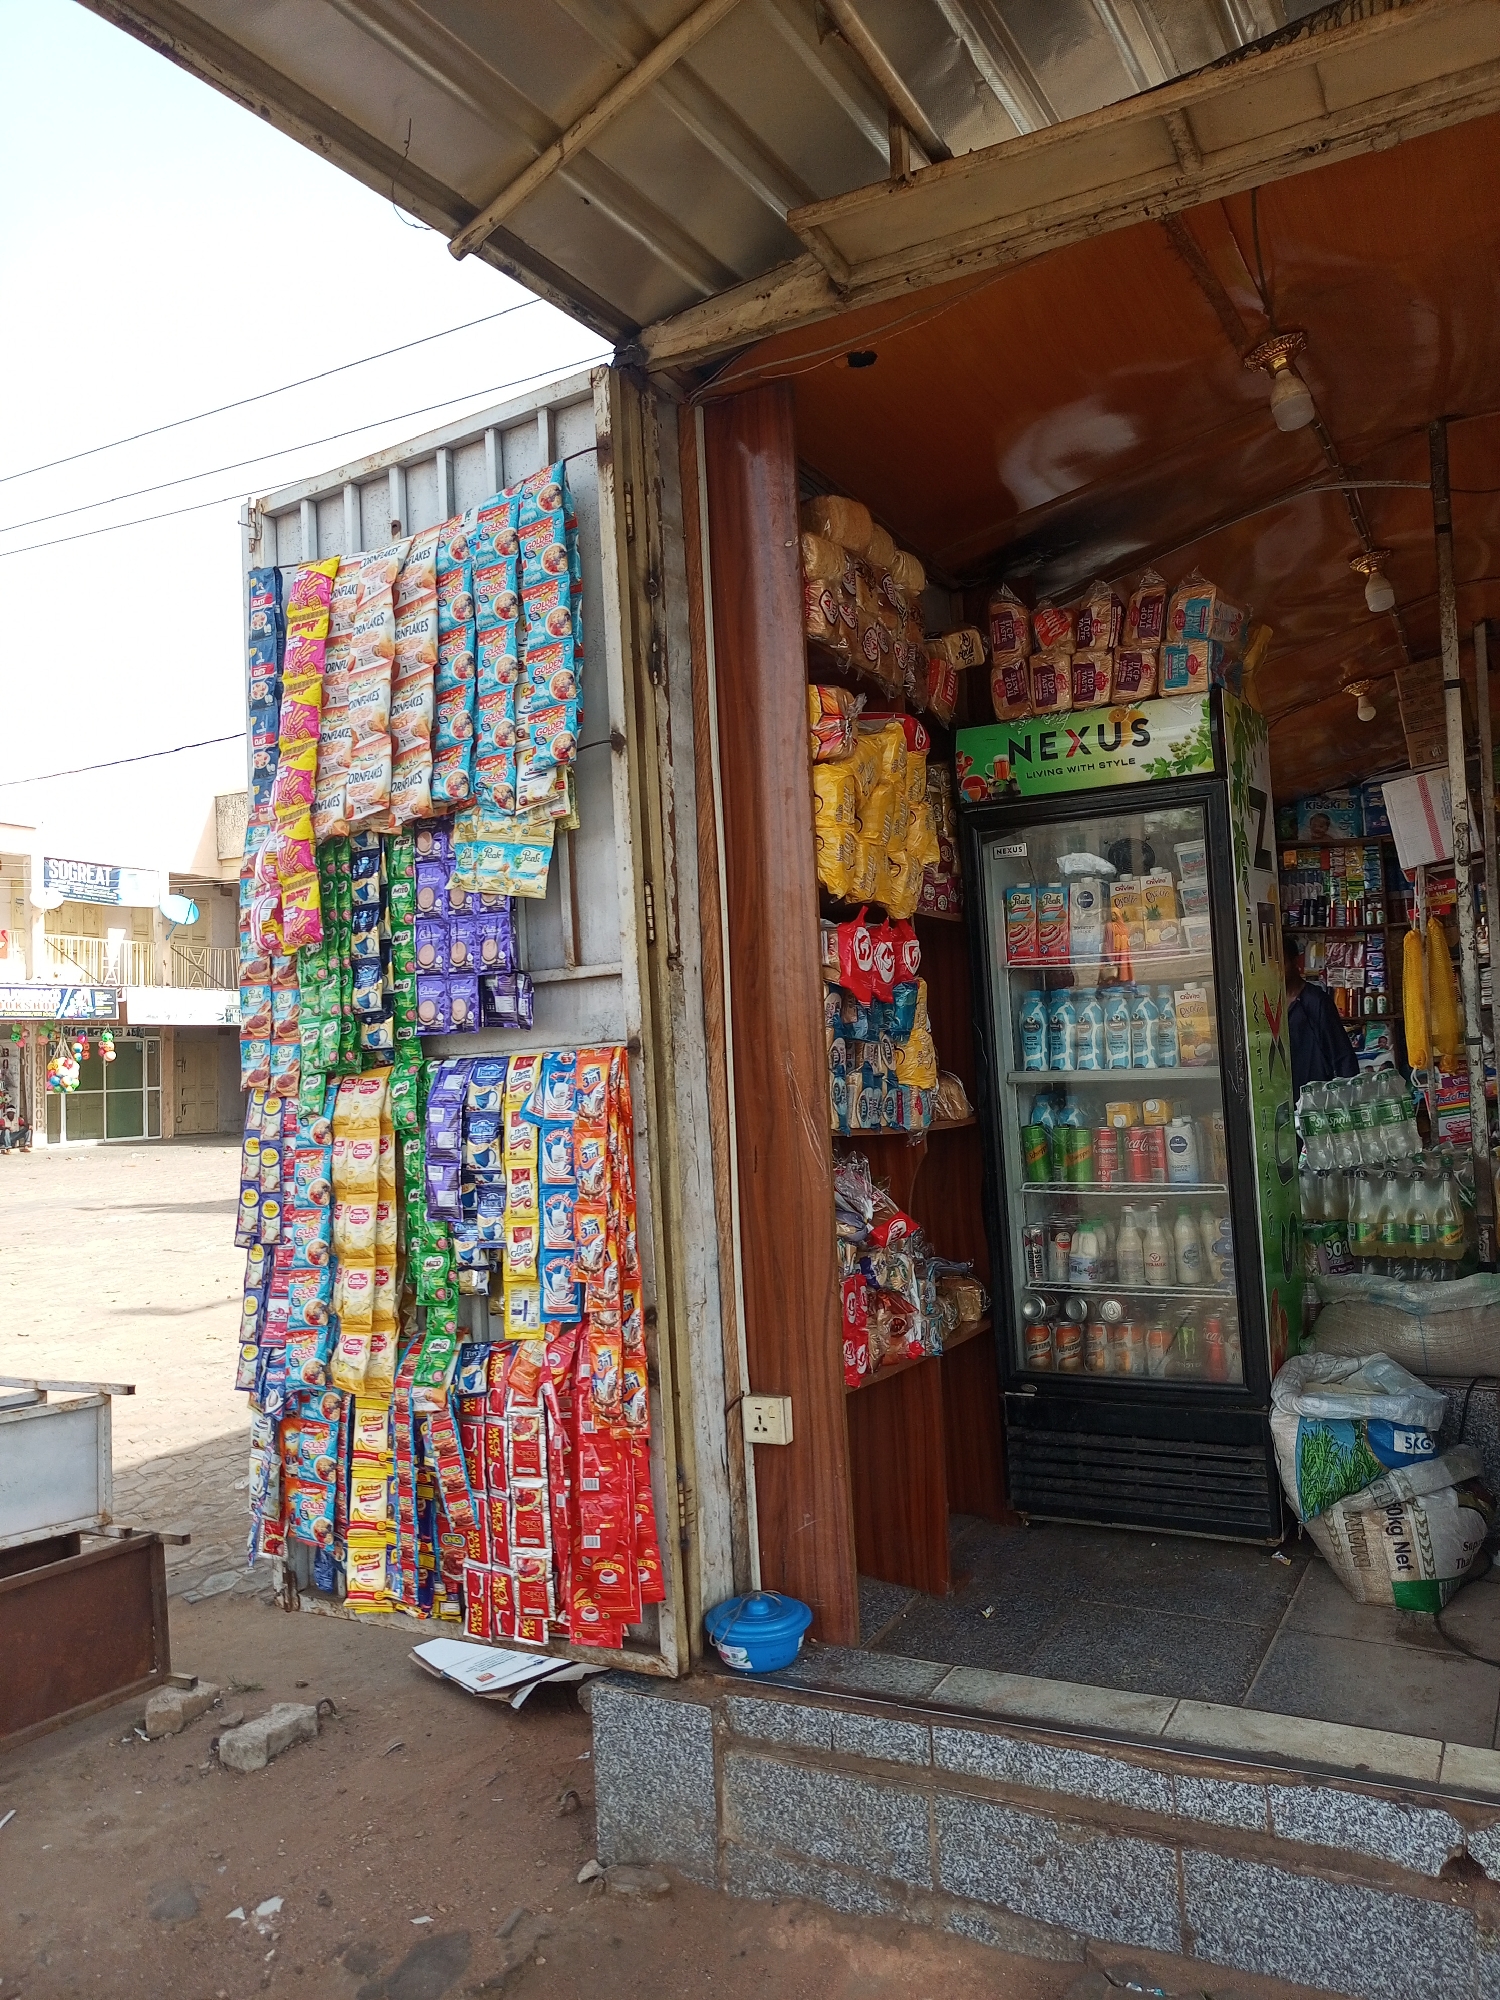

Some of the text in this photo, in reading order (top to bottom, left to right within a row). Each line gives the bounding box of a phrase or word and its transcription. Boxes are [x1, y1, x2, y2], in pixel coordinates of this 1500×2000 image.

[481, 518, 509, 534] GOLDEN
[525, 532, 554, 551] GOLDEN
[361, 545, 401, 567] CORNFLAKES
[331, 583, 358, 599] ORNFLAK
[479, 579, 507, 595] GOLDEN
[530, 593, 559, 613] GOLDEN
[352, 611, 385, 636] CORNFLAKES
[1139, 608, 1147, 628] TOP
[1145, 606, 1154, 629] TASTE
[999, 620, 1008, 642] TASTE
[1005, 620, 1014, 639] TOP
[1078, 617, 1086, 641] TASTE
[534, 656, 564, 676] GOLDEN
[1126, 662, 1134, 682] TASTE
[1005, 677, 1014, 697] TOP
[1010, 673, 1019, 695] TASTE
[1041, 674, 1049, 698] TASTE
[536, 718, 566, 737] GOLDEN
[254, 737, 267, 747] OATS
[1008, 718, 1150, 765] NEXUS
[346, 764, 384, 785] CORNFLAKES
[1026, 757, 1136, 779] LIVING WITH STYLE
[843, 786, 855, 825] LIGHT
[483, 846, 502, 859] Peak
[522, 848, 541, 863] Peak
[996, 846, 1023, 856] NEXUS
[48, 858, 113, 886] SOGREAT
[1146, 877, 1167, 886] Chivita
[393, 886, 409, 894] MILO
[1012, 894, 1030, 907] Peak
[1043, 894, 1061, 907] Peak
[392, 935, 409, 944] MILO
[394, 982, 409, 990] MILO
[1180, 992, 1201, 1000] Chivita
[304, 1032, 319, 1042] MILO
[1248, 785, 1298, 1285] NEXUS
[884, 1042, 892, 1058] TOP
[515, 1069, 531, 1078] Three
[583, 1072, 601, 1088] 3in1
[304, 1077, 319, 1087] MILO
[394, 1085, 408, 1094] MILO
[1436, 1089, 1470, 1103] Indomi
[514, 1127, 529, 1136] Three
[406, 1142, 419, 1150] MILO
[1029, 1146, 1048, 1158] Schwepp
[582, 1146, 599, 1162] 3in1
[409, 1192, 419, 1200] MIL
[515, 1185, 530, 1193] Three
[581, 1223, 599, 1239] 3in1
[425, 1258, 442, 1268] MILO
[431, 1342, 447, 1350] MILO
[598, 1354, 613, 1371] 3in1
[360, 1414, 384, 1425] Checkers
[303, 1440, 328, 1450] GOLDEN
[1405, 1436, 1433, 1451] 5KG
[356, 1484, 382, 1495] Checkers
[301, 1500, 326, 1511] GOLDEN
[354, 1554, 379, 1564] Checkers
[1392, 1541, 1414, 1571] Net
[640, 1560, 654, 1568] TEA
